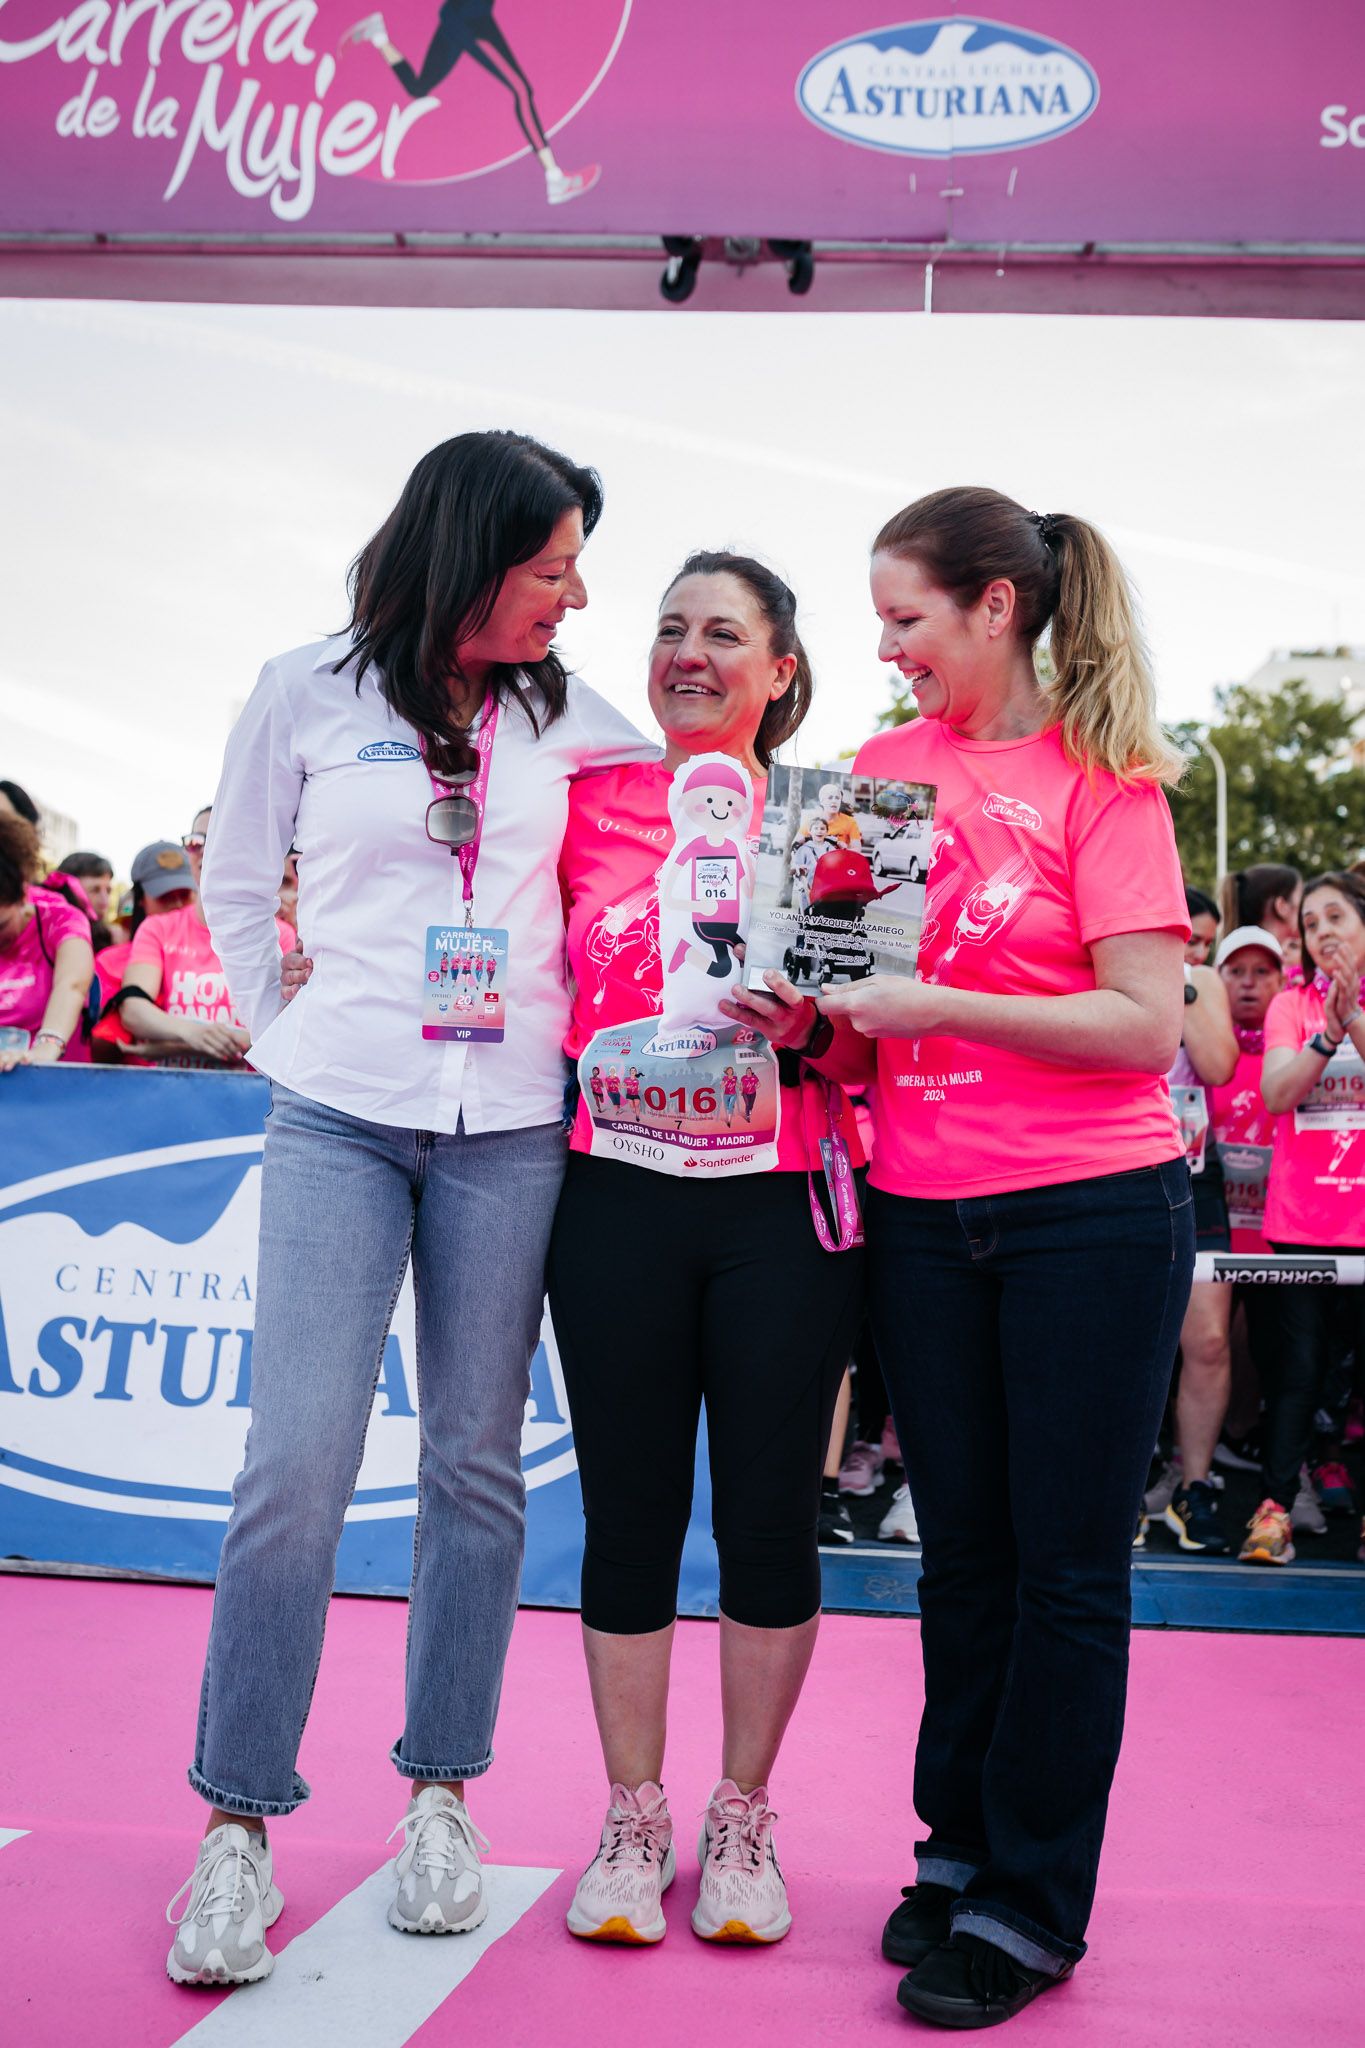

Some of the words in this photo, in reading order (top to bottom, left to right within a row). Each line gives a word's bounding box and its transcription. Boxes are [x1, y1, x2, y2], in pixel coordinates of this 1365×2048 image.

[823, 66, 1072, 119] ASTURIANA
[56, 67, 120, 138] de
[132, 66, 179, 138] la
[164, 53, 442, 221] Mujer
[363, 749, 416, 759] ASTURIANA
[705, 889, 727, 898] 016
[769, 911, 811, 924] YOLANDA
[812, 914, 853, 928] VÁZQUEZ
[853, 922, 905, 936] MAZARIEGO
[440, 931, 481, 940] CARRERA
[435, 938, 493, 953] MUJER
[895, 941, 913, 950] Mujer
[457, 995, 472, 1005] 20
[456, 1030, 472, 1039] VIP
[893, 1074, 926, 1087] ARRERA
[927, 1075, 936, 1087] DE
[937, 1074, 948, 1086] LA
[948, 1069, 983, 1086] MUJER
[1324, 1076, 1364, 1092] 016
[644, 1086, 717, 1114] 016
[923, 1089, 946, 1102] 2024
[675, 1120, 682, 1130] 7
[611, 1122, 650, 1136] CARRERA
[652, 1130, 663, 1140] DE
[665, 1132, 677, 1142] LA
[679, 1135, 708, 1147] MUJER
[716, 1135, 755, 1146] MADRID
[613, 1137, 665, 1161] OYSHO
[699, 1153, 755, 1168] Santander
[56, 1264, 254, 1301] CENTRA
